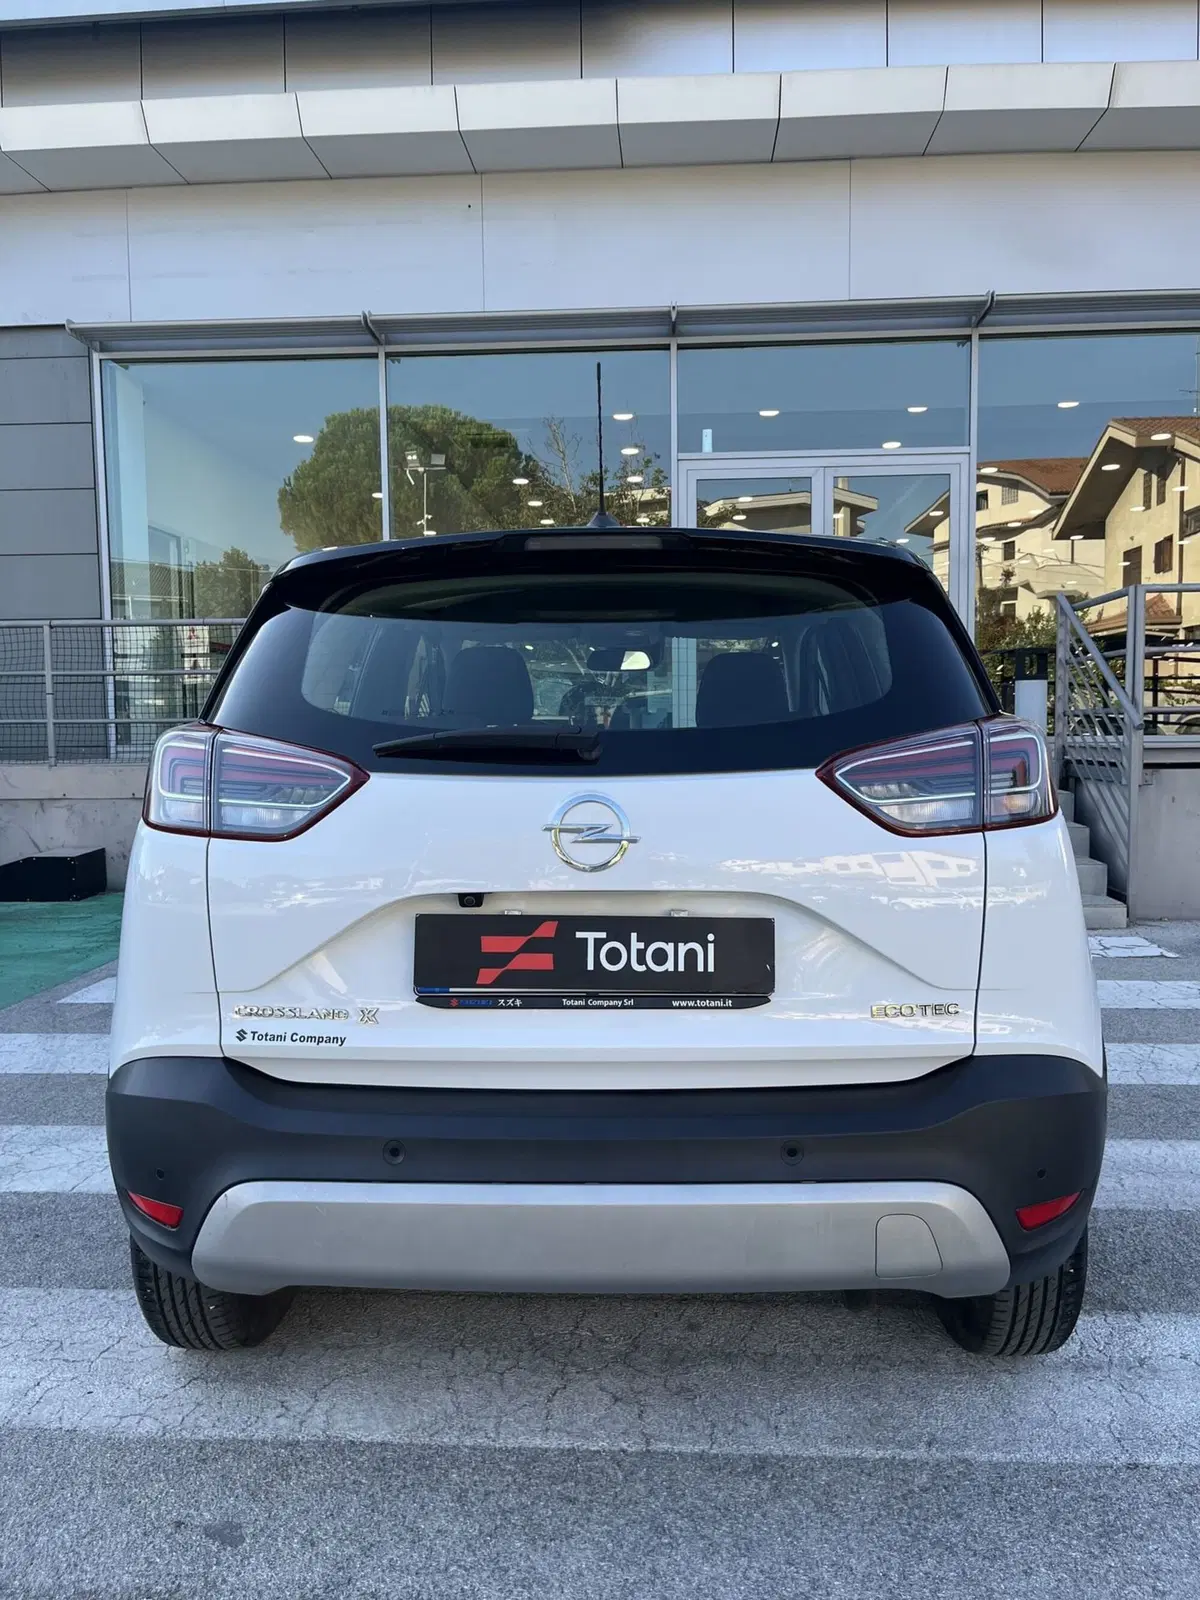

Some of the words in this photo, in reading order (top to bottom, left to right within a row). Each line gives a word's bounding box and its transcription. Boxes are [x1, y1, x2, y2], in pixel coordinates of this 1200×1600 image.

[575, 931, 715, 972] Totani
[497, 998, 523, 1007] スズキ
[562, 998, 586, 1006] Totani
[587, 998, 622, 1007] Company
[623, 998, 634, 1006] Srl
[672, 998, 733, 1008] www.totani.it
[870, 1002, 960, 1019] ECOTEC
[233, 1004, 349, 1021] CROSSLAND
[358, 1006, 380, 1025] X
[250, 1030, 287, 1043] Totani
[290, 1032, 347, 1047] Company
